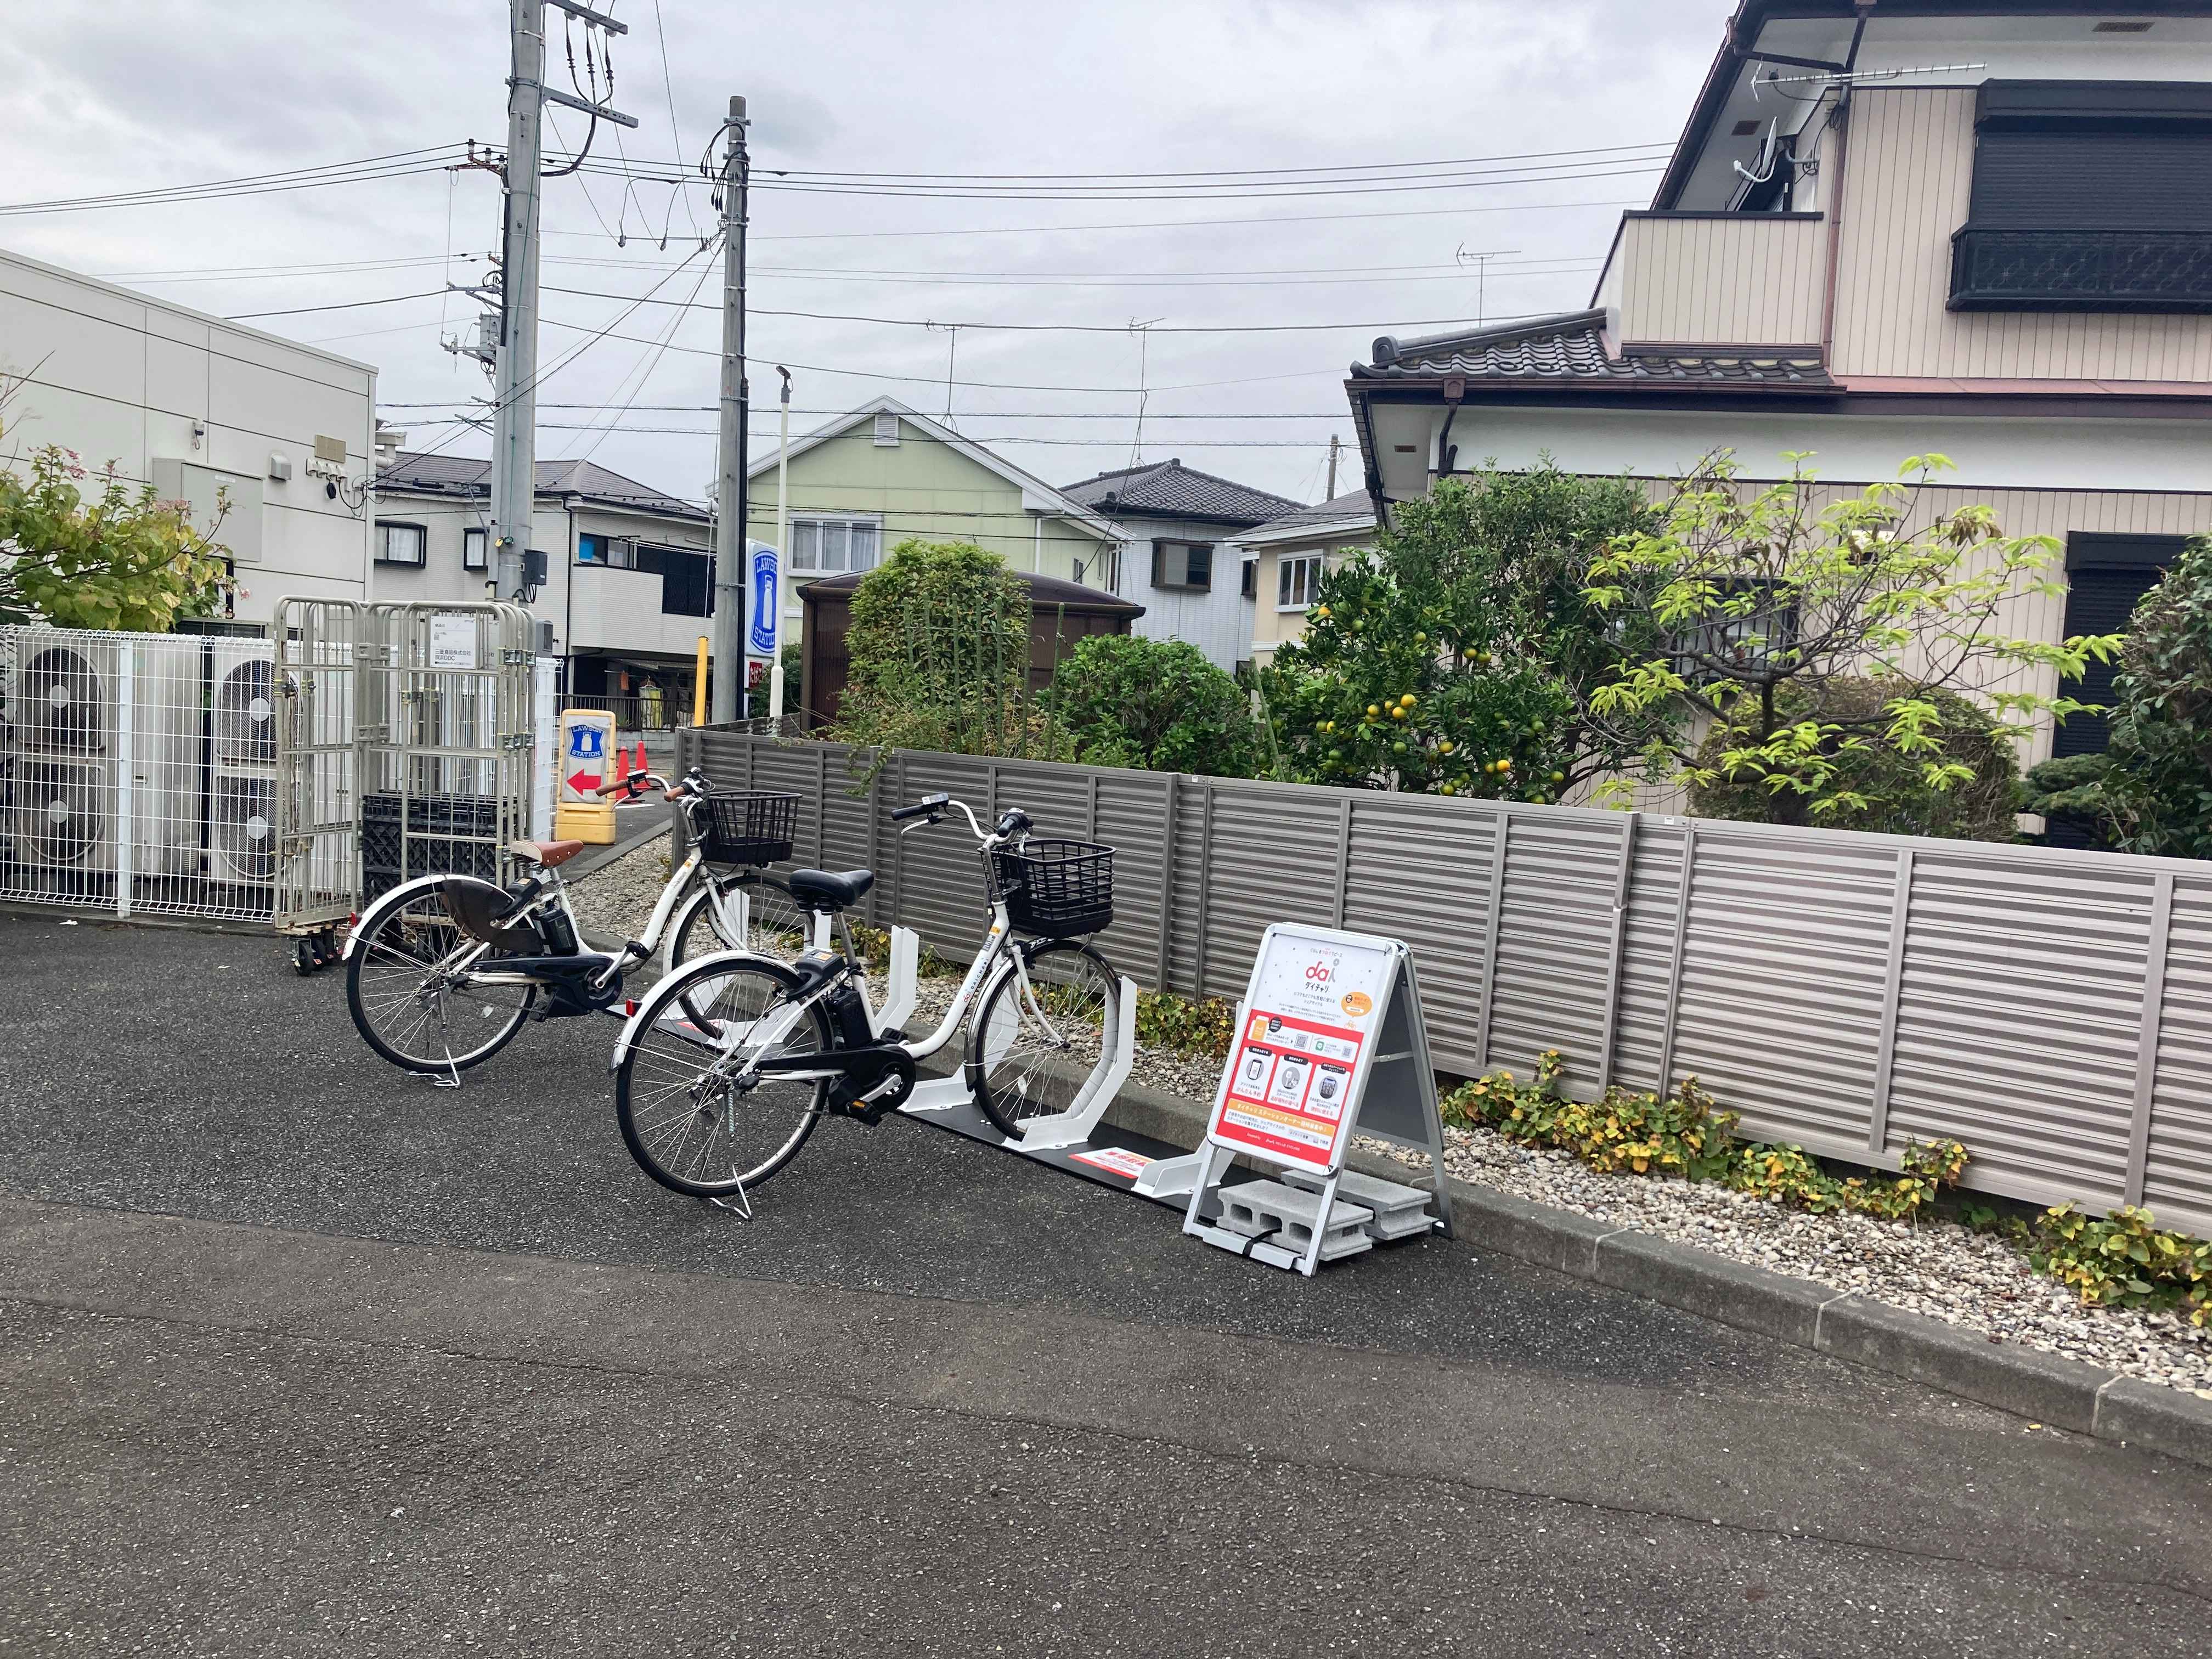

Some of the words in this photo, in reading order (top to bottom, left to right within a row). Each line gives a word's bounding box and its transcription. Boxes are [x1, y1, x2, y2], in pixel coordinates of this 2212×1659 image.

[756, 557, 777, 574] LAWSO
[754, 625, 775, 645] STATIO
[1305, 981, 1329, 993] ダイチャリ
